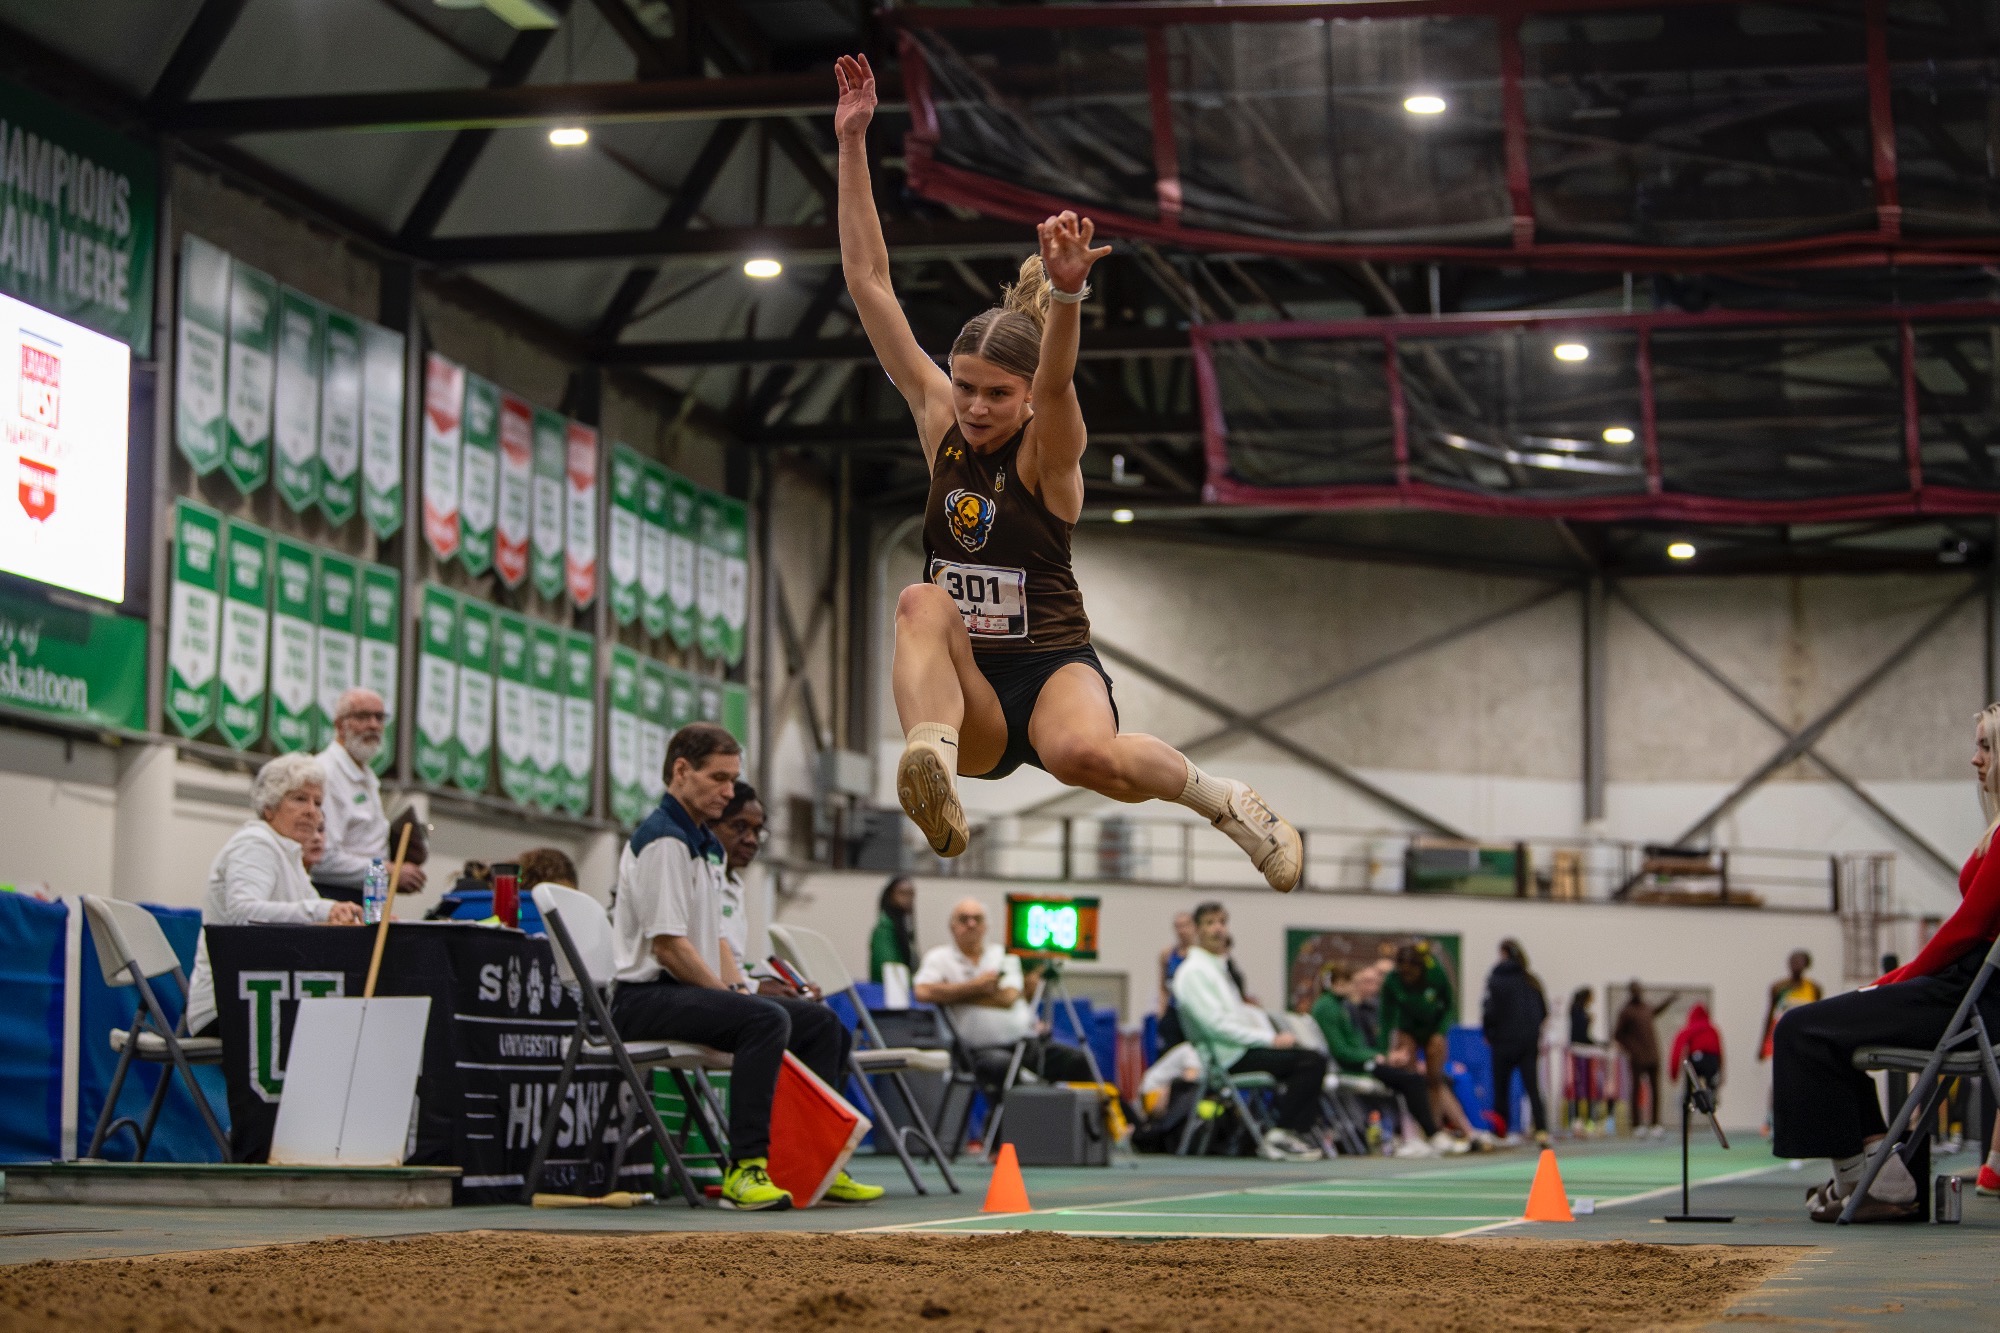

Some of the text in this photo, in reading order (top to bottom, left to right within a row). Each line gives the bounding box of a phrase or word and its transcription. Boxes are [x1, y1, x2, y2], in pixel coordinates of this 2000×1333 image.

[57, 227, 129, 313] HERE
[946, 571, 1001, 605] 301
[499, 1033, 559, 1058] UNIVERSITY
